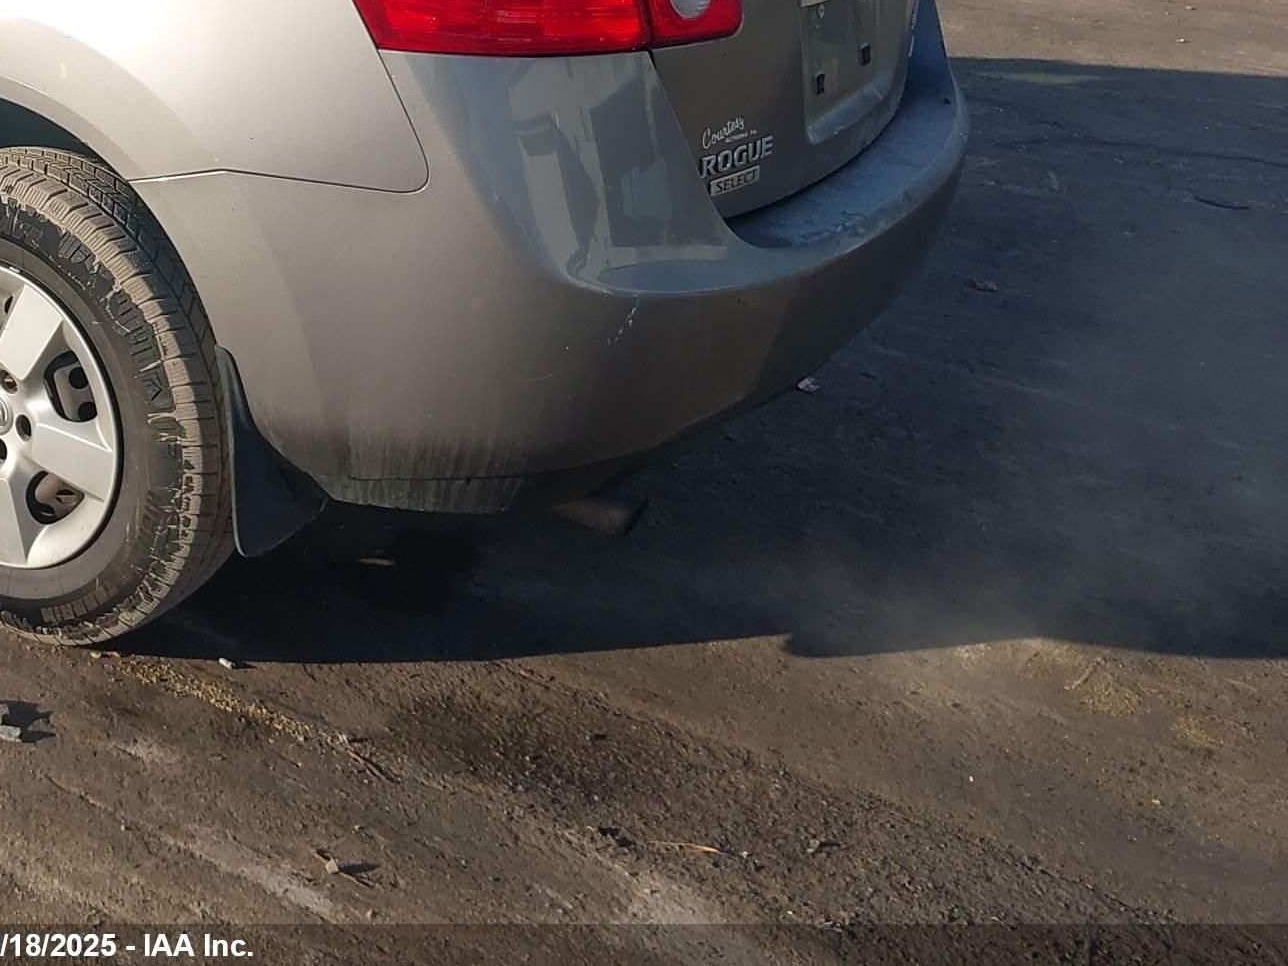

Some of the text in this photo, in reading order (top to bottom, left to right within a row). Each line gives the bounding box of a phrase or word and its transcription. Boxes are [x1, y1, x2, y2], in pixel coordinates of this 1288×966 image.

[702, 117, 745, 149] Courtesy
[700, 135, 773, 178] ROGUE
[715, 169, 759, 193] SELECT
